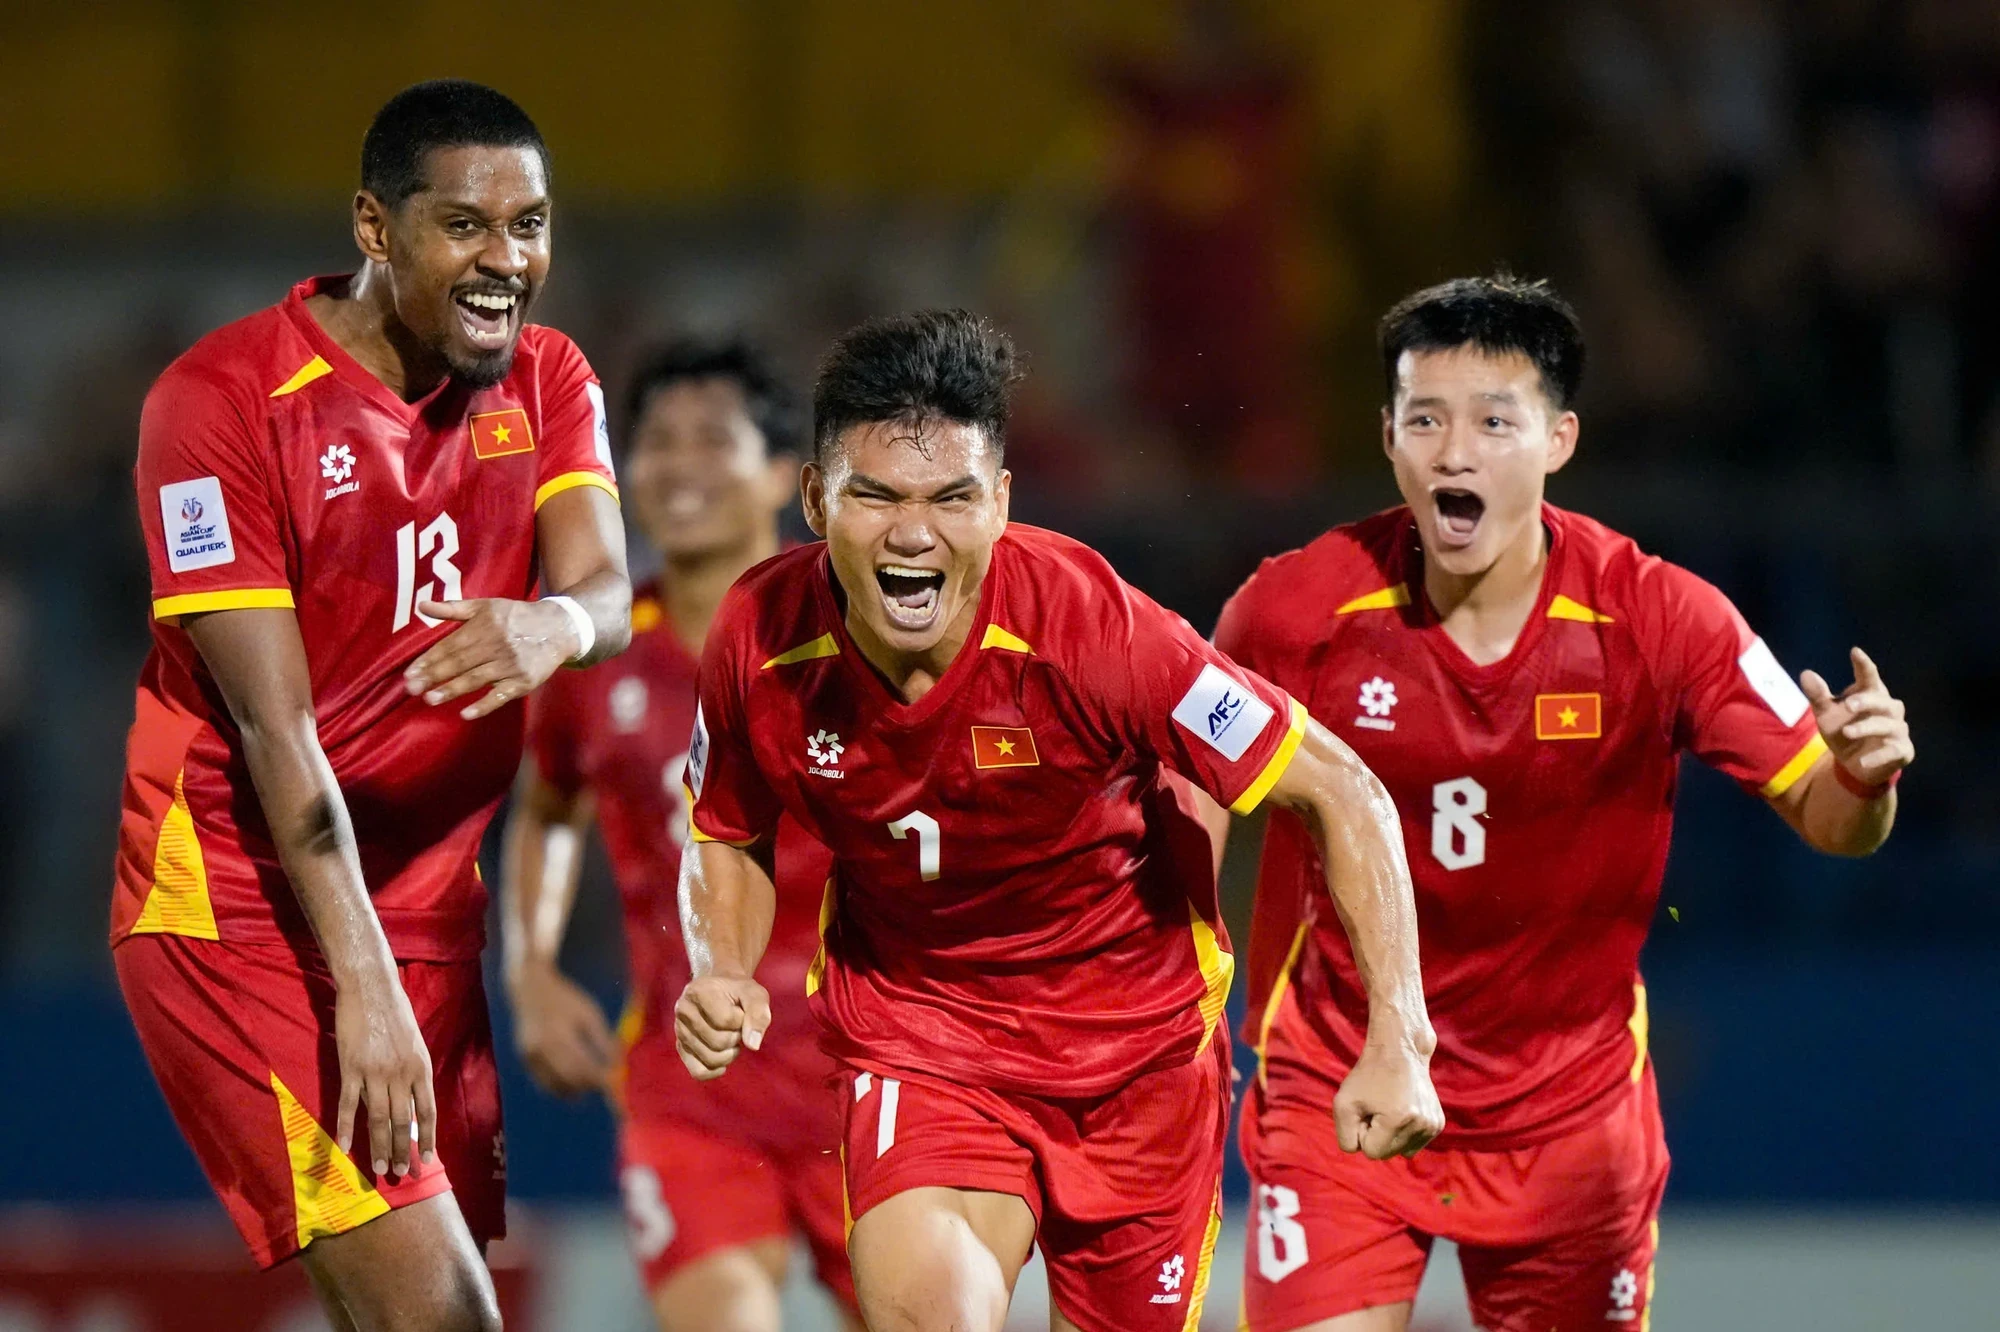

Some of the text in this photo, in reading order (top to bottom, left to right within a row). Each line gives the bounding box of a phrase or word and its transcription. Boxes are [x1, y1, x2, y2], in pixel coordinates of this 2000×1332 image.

[176, 541, 227, 557] QUALIFIERS
[180, 530, 200, 538] ASIAN
[392, 511, 463, 634] 13
[1208, 689, 1240, 736] AFC
[808, 766, 845, 779] JOGARBOLA
[887, 810, 941, 883] 7
[1431, 776, 1488, 871] 8
[1258, 1184, 1310, 1284] 8
